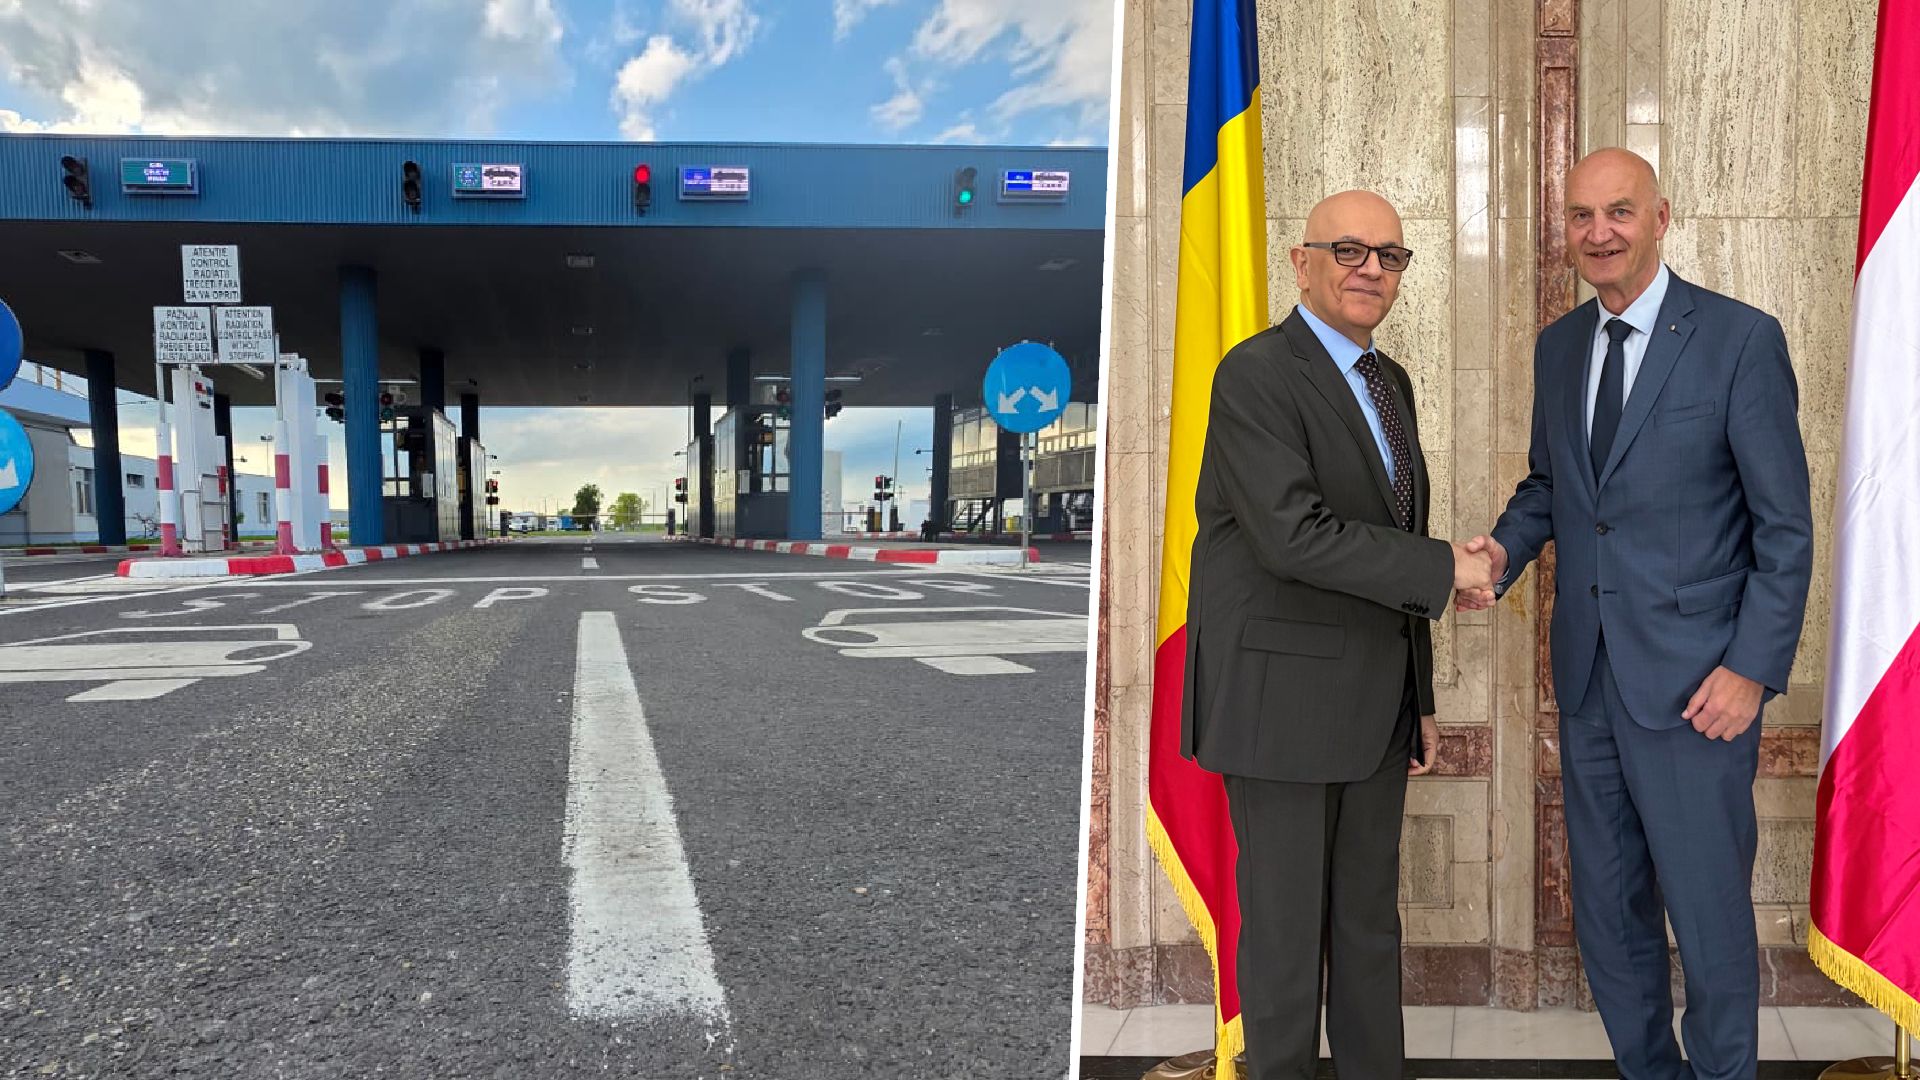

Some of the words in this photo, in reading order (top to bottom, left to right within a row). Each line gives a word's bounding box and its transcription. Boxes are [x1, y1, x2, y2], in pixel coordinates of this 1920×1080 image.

[191, 258, 233, 268] CONTROL
[218, 279, 238, 288] FARA
[225, 309, 264, 318] ATTENTION
[160, 320, 206, 330] KONTROLA
[225, 319, 264, 329] RADIATION
[218, 330, 252, 340] CONTROL
[253, 330, 272, 340] PASS
[231, 340, 260, 350] WITHOUT
[228, 351, 265, 361] STOPPING
[627, 578, 1003, 605] STOP
[118, 587, 551, 619] STOP
